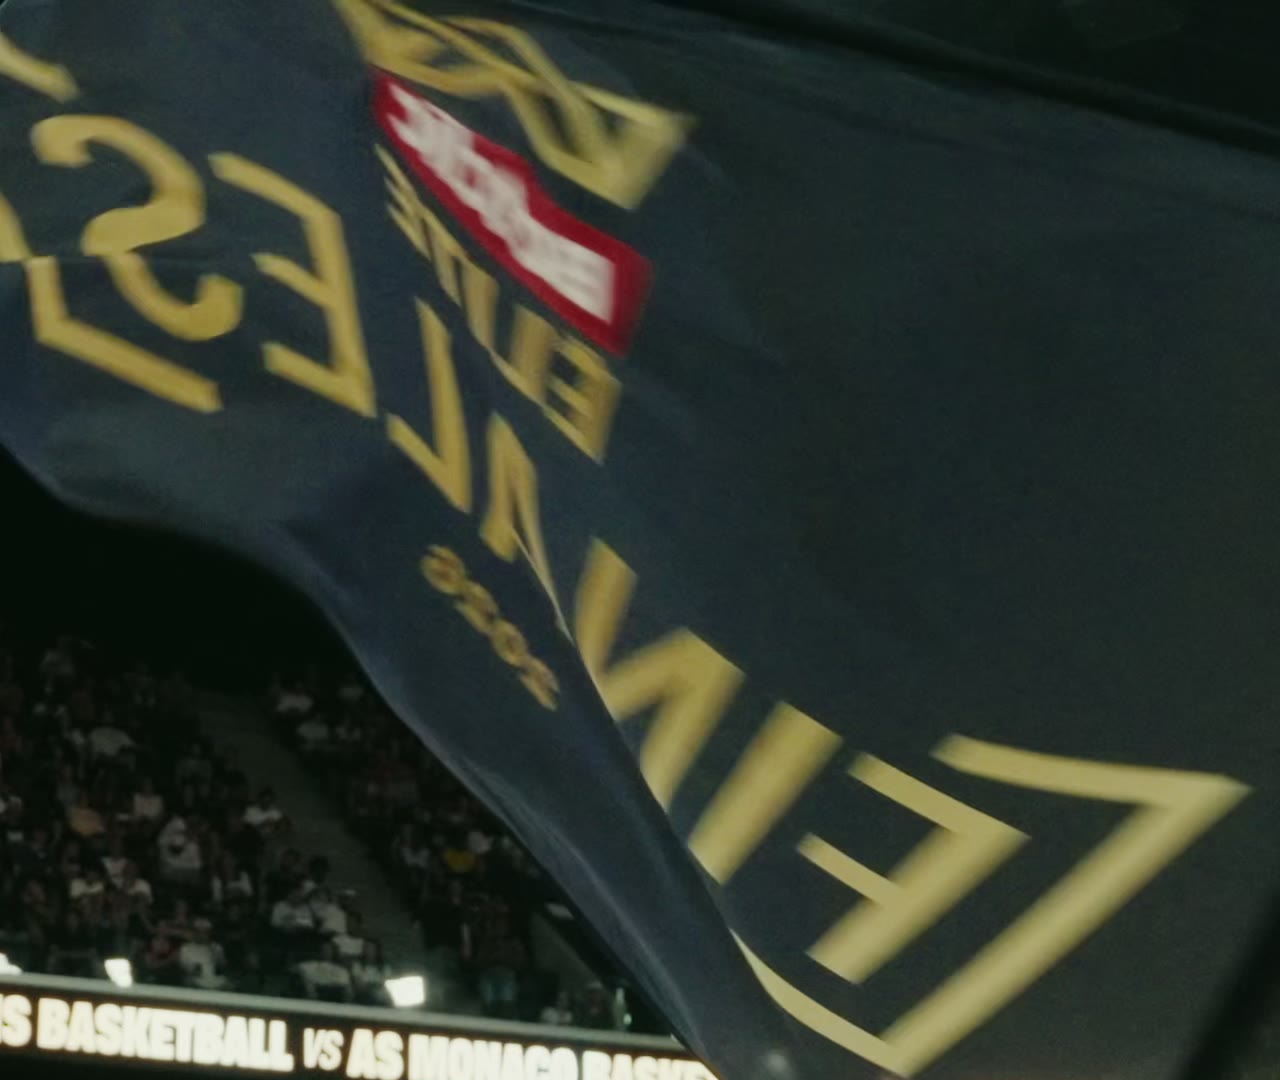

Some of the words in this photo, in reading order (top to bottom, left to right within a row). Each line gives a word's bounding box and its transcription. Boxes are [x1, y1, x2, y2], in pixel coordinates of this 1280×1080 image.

[37, 999, 296, 1072] BASKETBALL
[303, 1028, 344, 1070] VS
[346, 1028, 405, 1080] AS
